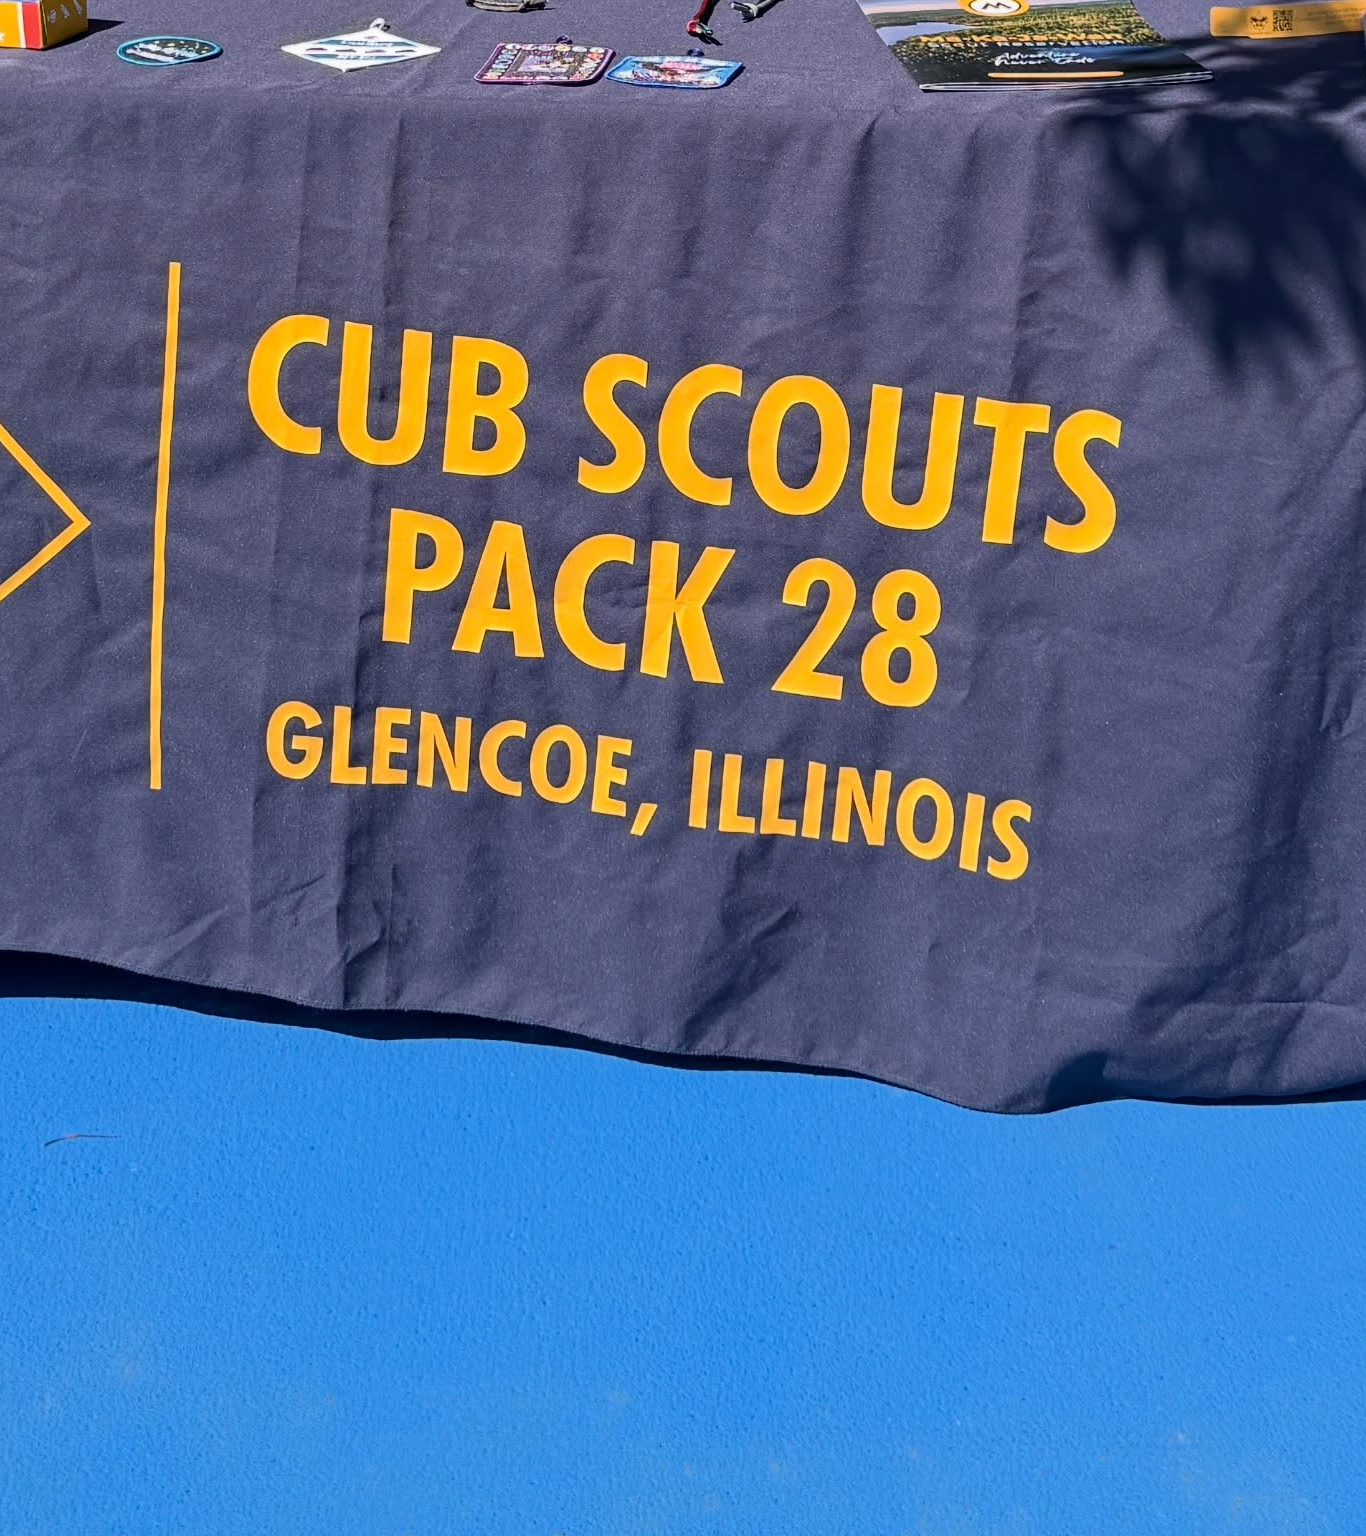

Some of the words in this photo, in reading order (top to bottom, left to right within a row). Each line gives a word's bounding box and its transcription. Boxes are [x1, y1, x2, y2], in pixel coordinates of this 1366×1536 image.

[247, 314, 530, 477] CUB
[577, 353, 1122, 554] SCOUTS
[381, 508, 736, 685] PACK
[771, 558, 942, 708] 28
[265, 700, 659, 837] GLENCOE,
[688, 749, 1032, 881] ILLINOIS
